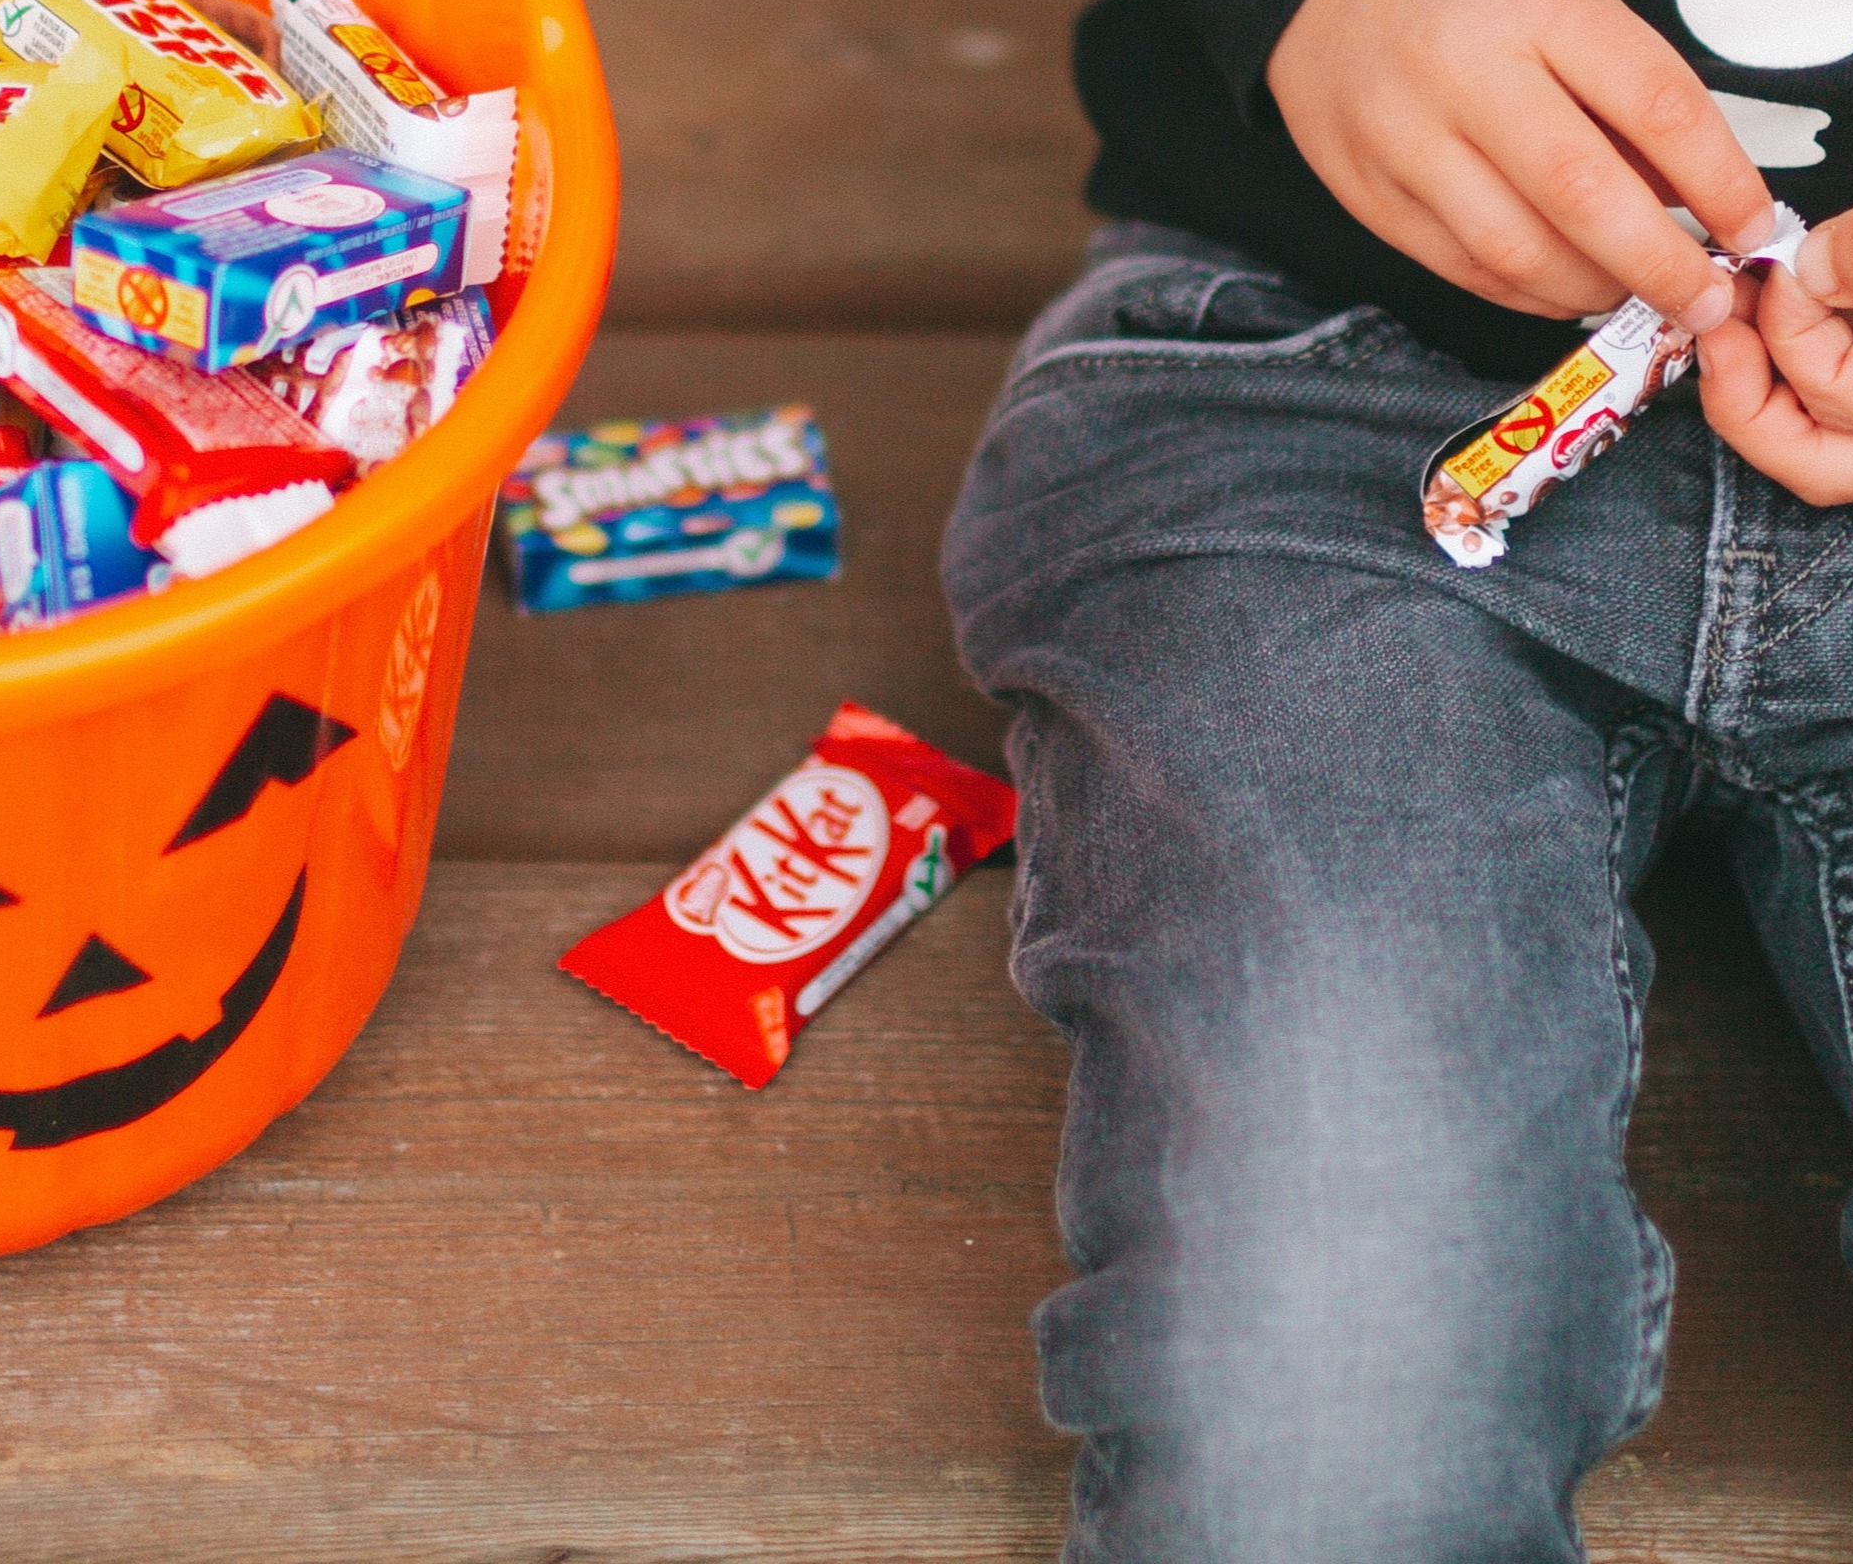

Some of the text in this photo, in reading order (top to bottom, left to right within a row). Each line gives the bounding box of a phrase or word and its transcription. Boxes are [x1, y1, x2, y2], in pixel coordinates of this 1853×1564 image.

[1557, 370, 1606, 418] arachides
[1560, 372, 1584, 397] sans
[1454, 441, 1490, 474] Peanut
[1470, 456, 1494, 479] Free
[1478, 465, 1504, 489] Facility
[729, 788, 870, 940] KitKat
